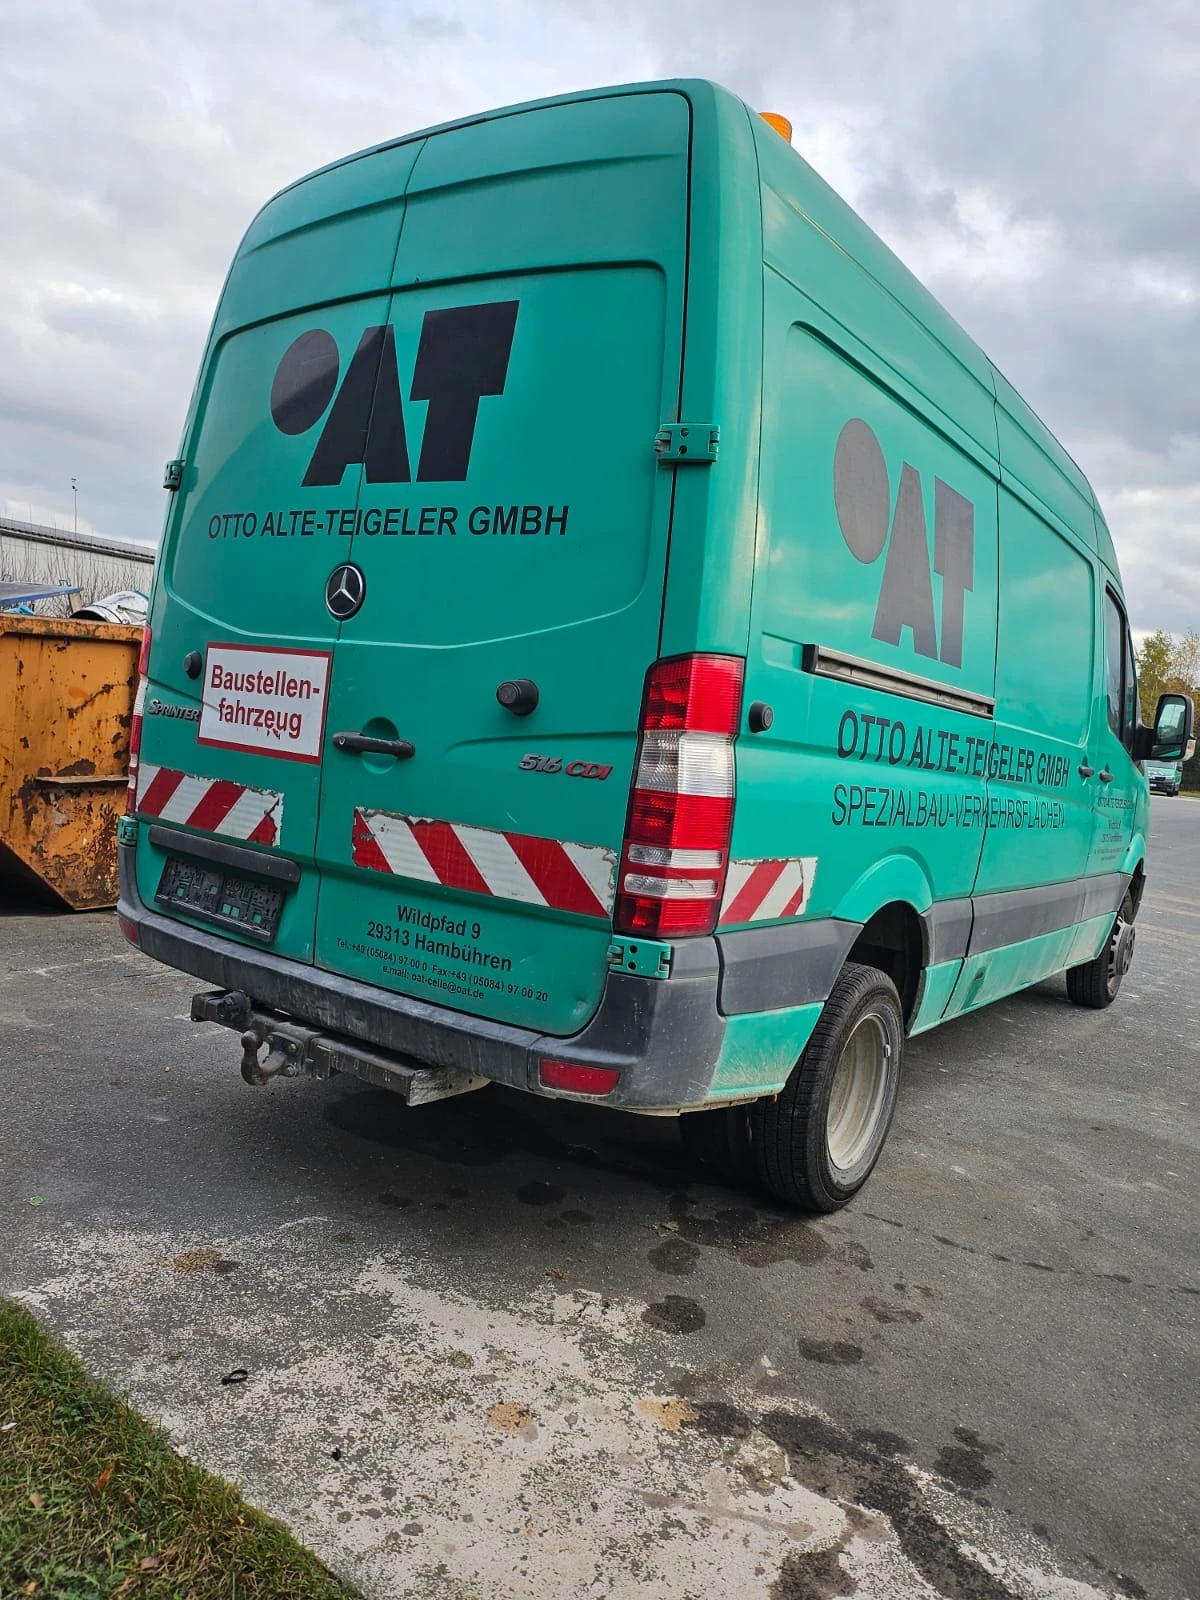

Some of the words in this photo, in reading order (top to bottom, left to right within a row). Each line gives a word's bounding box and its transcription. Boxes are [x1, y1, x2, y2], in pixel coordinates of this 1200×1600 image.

[270, 300, 520, 487] OAT
[208, 512, 257, 539] OTTO
[260, 506, 458, 537] ALTE-TEIGELER
[468, 505, 569, 536] GMBH
[833, 418, 974, 669] OAT
[211, 664, 320, 699] Baustellen-
[218, 697, 302, 739] fahrzeug
[519, 753, 562, 774] 516
[565, 760, 613, 780] CDI
[837, 709, 906, 765] OTTO
[906, 725, 1034, 783] ALTE-TEIGELER
[1037, 752, 1070, 787] GMBH
[831, 783, 1065, 829] SPEZIALBAU-VERKEHRSFLÄCHEN
[397, 904, 467, 937] Wildpfad
[471, 922, 481, 939] 9
[367, 921, 410, 946] 29313
[414, 933, 512, 972] Hambühren
[366, 946, 397, 964] (05084)
[398, 956, 408, 966] 97
[410, 959, 420, 969] 00
[422, 962, 428, 971] 0
[432, 965, 467, 982] Fax:+49
[469, 973, 504, 993] (05084)
[507, 983, 519, 995] 97
[521, 987, 533, 999] 00
[535, 990, 549, 1002] 20
[411, 972, 485, 1000] oat-celle@oat.de
